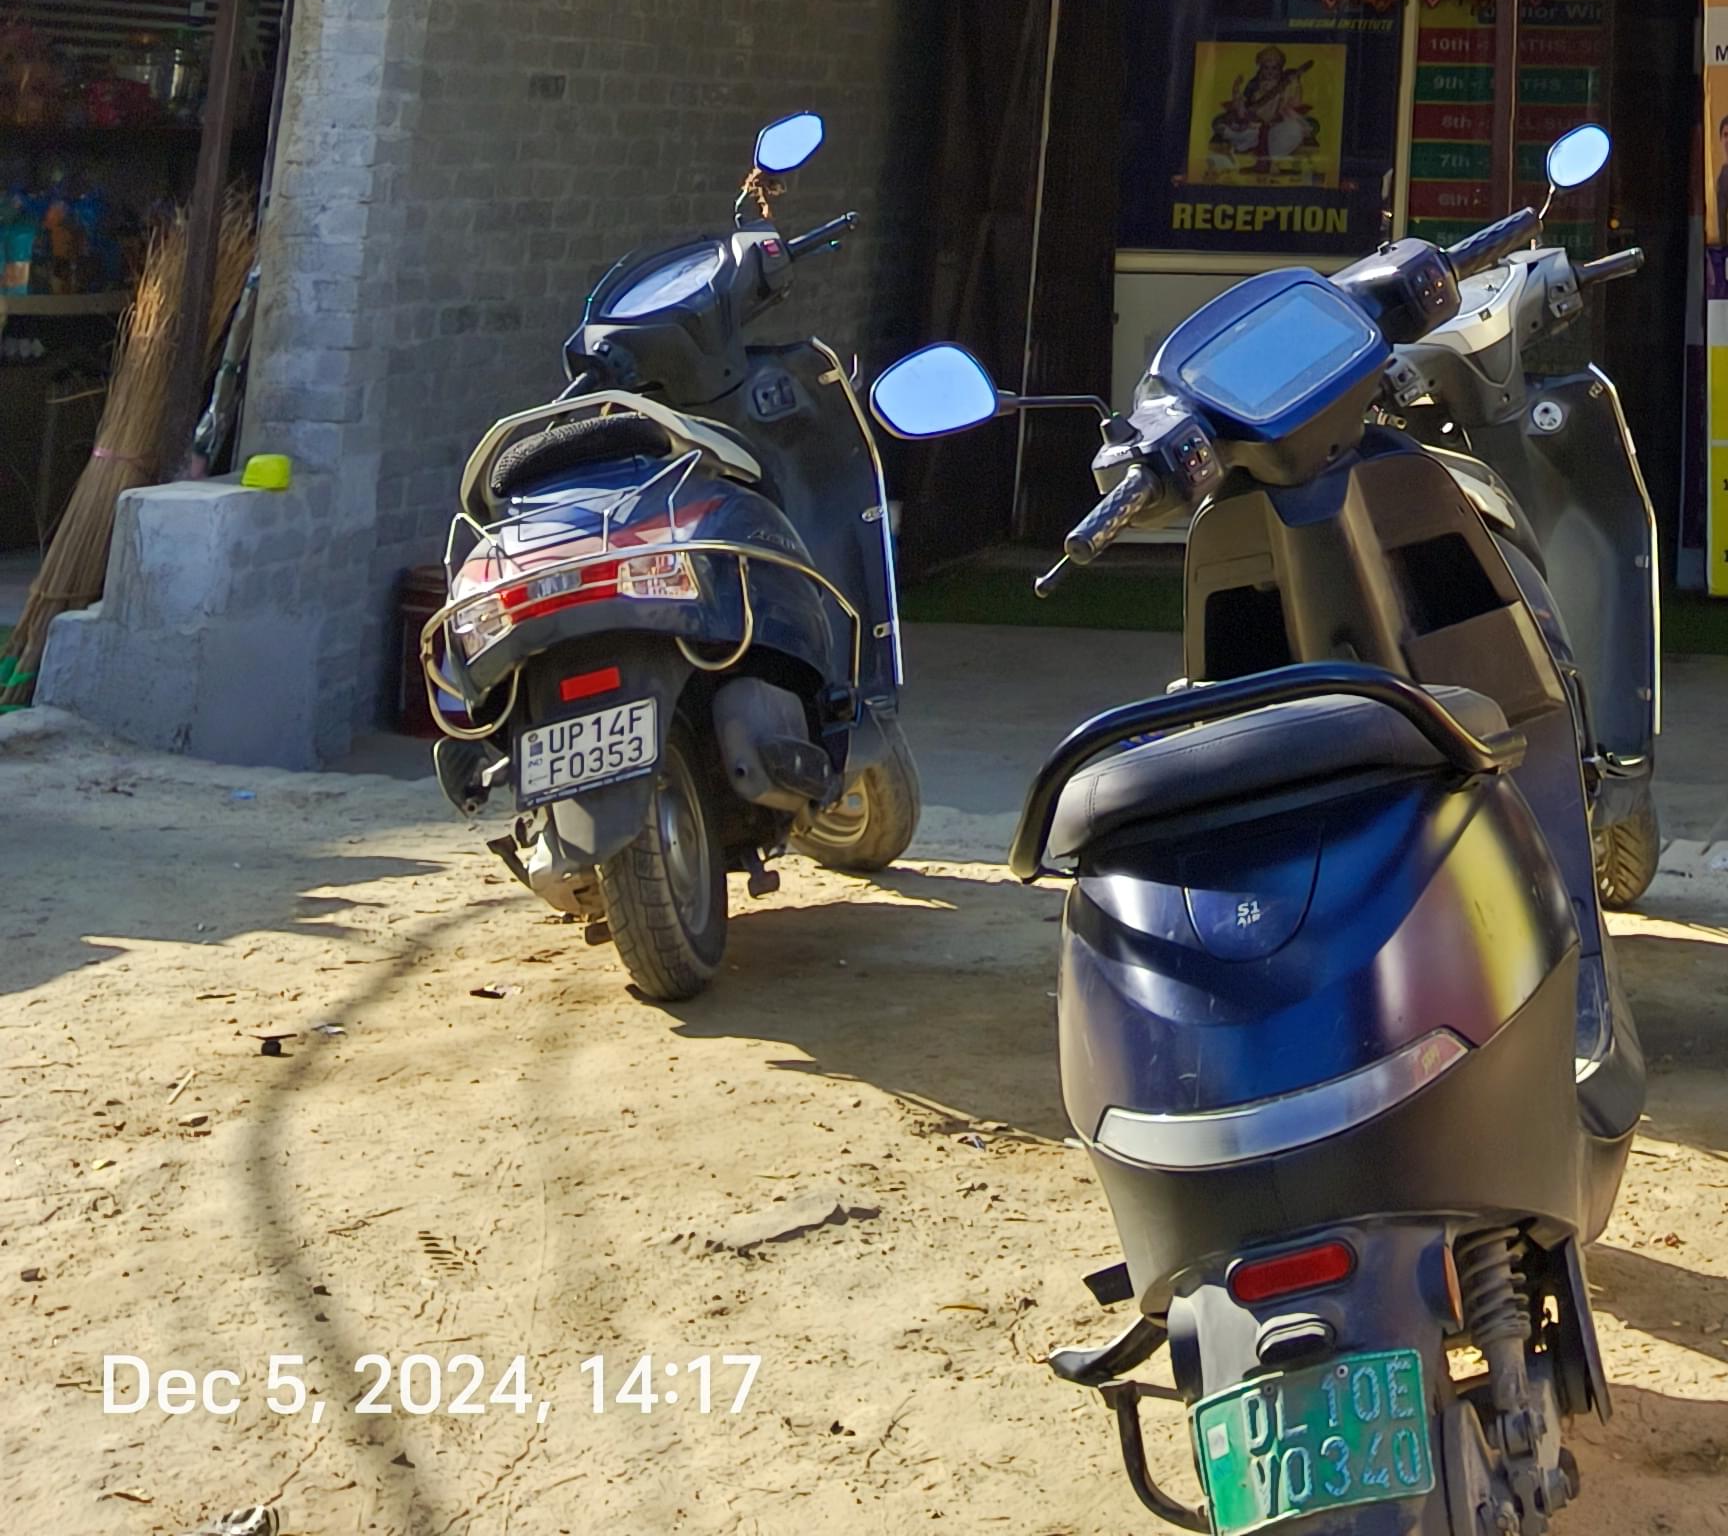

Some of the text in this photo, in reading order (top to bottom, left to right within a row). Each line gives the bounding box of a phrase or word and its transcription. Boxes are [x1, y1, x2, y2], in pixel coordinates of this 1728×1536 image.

[1172, 203, 1347, 234] RECEPTION
[549, 737, 644, 786] F0353
[1237, 901, 1260, 917] S1
